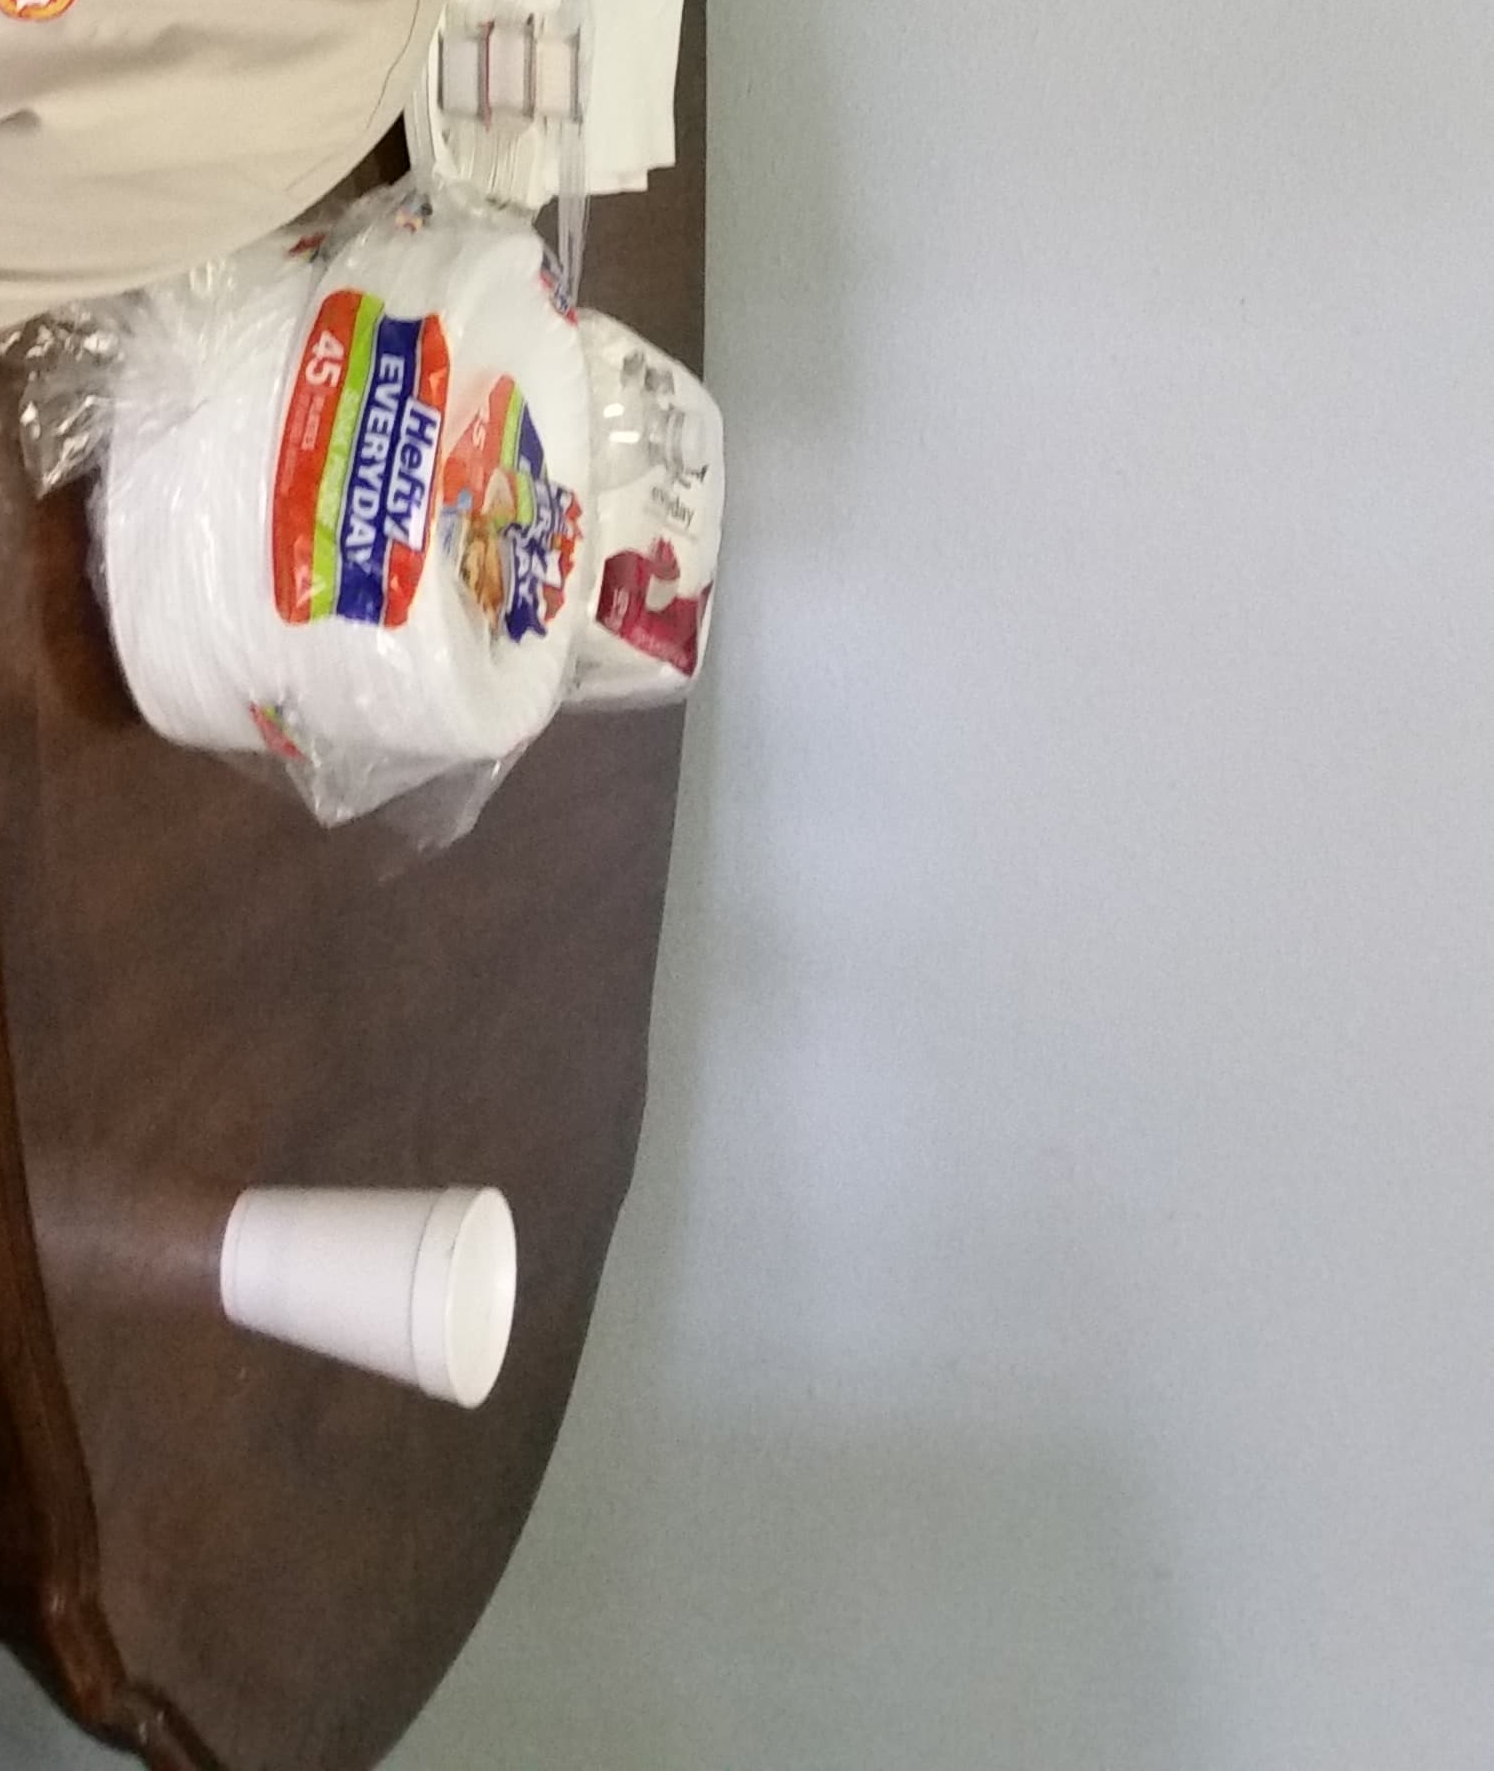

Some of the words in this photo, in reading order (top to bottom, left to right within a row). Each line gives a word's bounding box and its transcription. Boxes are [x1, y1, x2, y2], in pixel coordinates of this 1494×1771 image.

[305, 329, 344, 389] 45
[344, 355, 406, 575] EVERYDAY
[387, 407, 438, 545] Hefty
